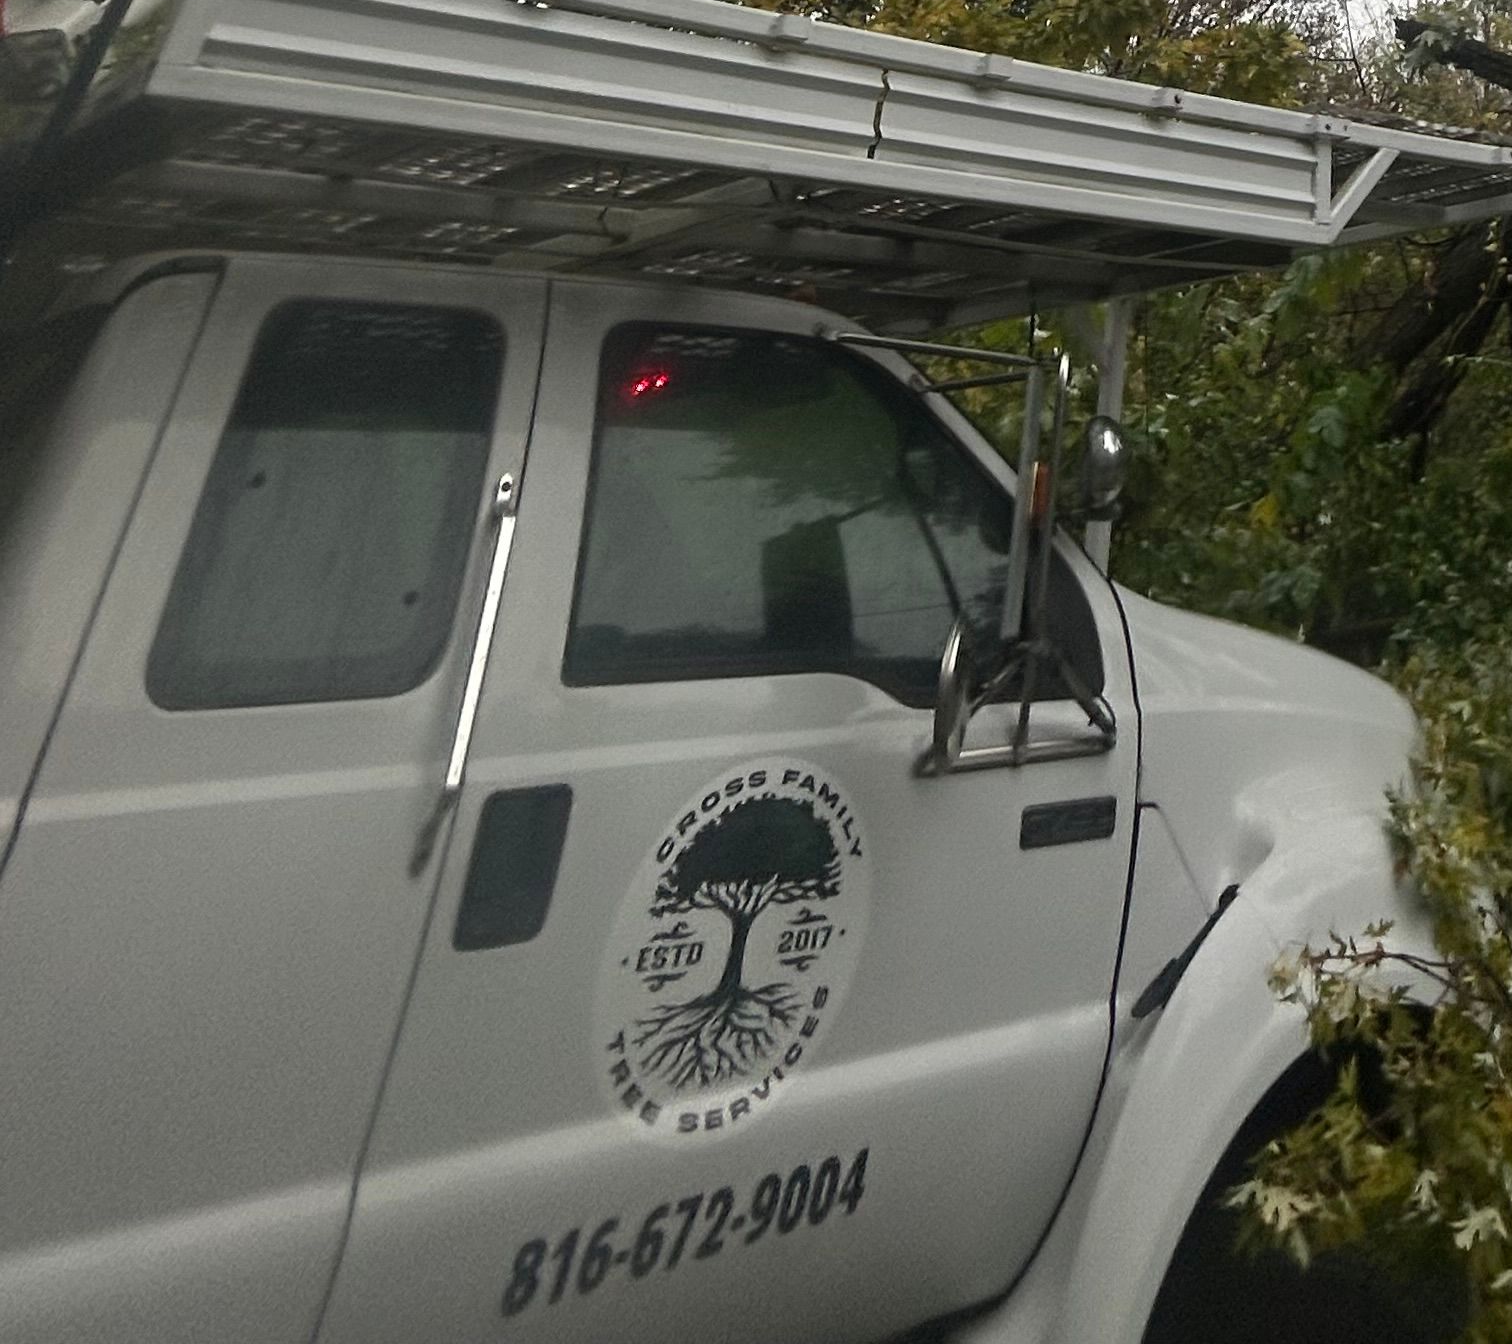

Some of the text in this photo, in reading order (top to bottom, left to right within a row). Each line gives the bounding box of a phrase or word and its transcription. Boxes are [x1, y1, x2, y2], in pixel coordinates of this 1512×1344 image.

[656, 769, 863, 863] CROSS FAMILY
[635, 924, 834, 973] ESTD 2017
[606, 984, 830, 1134] TREE SERVICES
[501, 1146, 870, 1318] 816-672-9004
